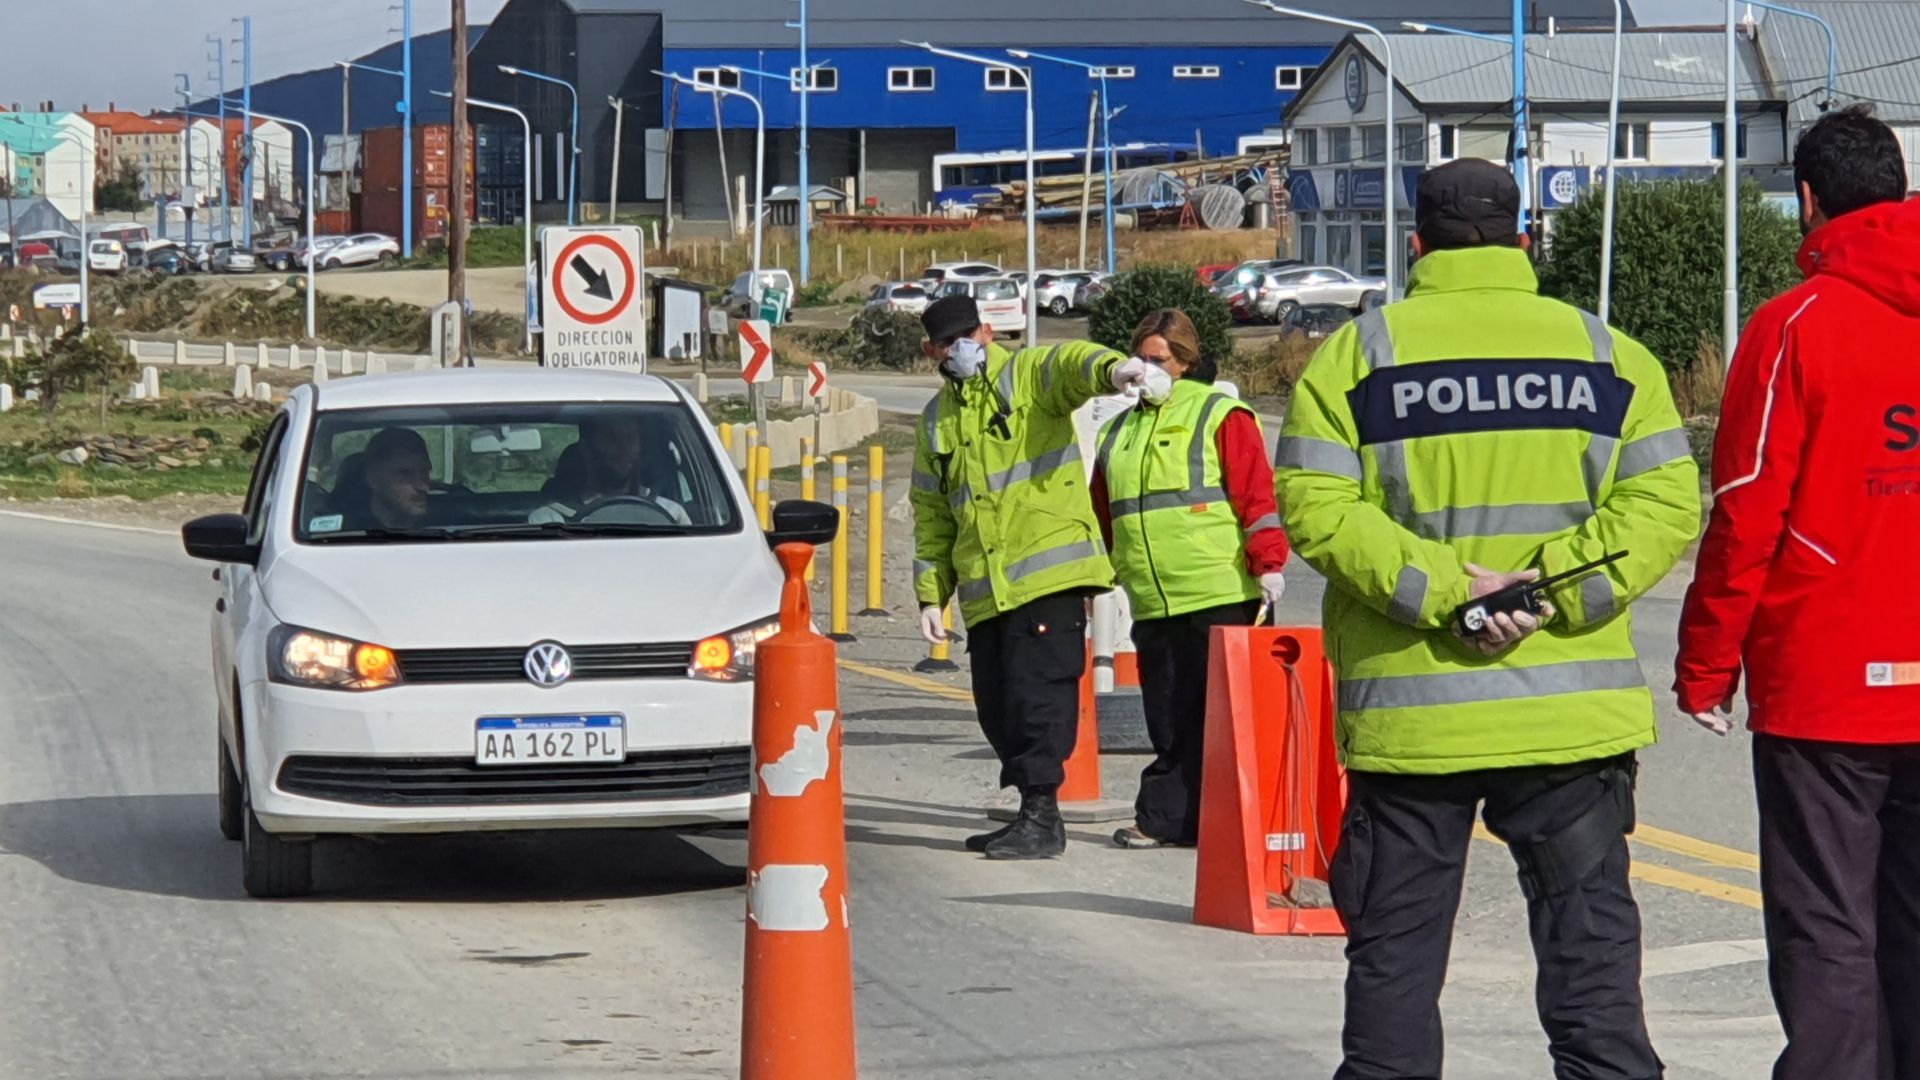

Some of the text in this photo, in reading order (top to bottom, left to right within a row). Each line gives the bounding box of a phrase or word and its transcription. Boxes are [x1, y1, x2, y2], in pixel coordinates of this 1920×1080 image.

[558, 330, 633, 347] DIRECCION
[551, 350, 640, 368] OBLIGATORIA
[1392, 373, 1598, 419] POLICIA
[484, 731, 616, 759] AA 162 PL
